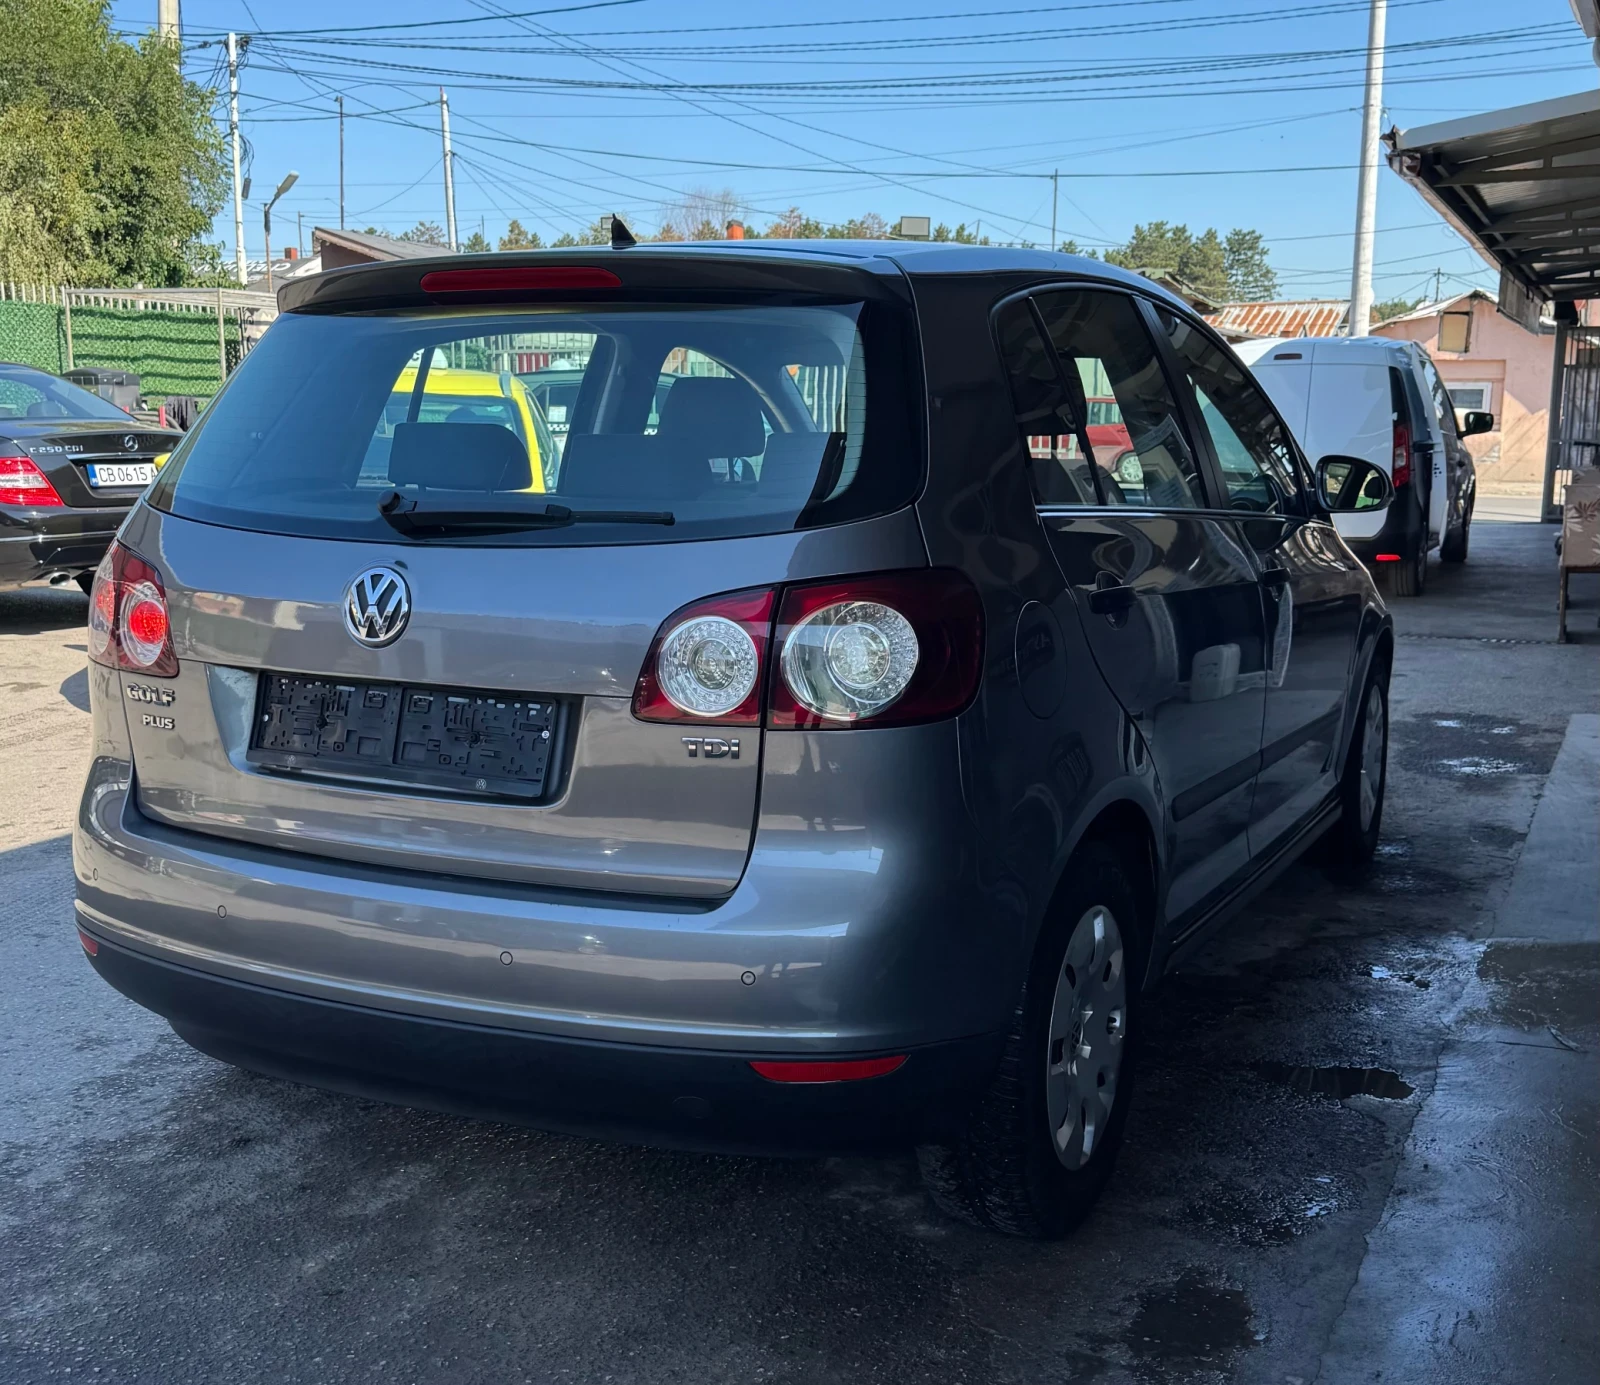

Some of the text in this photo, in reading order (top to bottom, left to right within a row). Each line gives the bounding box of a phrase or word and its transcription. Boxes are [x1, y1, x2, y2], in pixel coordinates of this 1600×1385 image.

[65, 444, 83, 452] CDI
[99, 467, 116, 482] CB
[117, 466, 147, 482] 0615
[346, 567, 410, 642] VW
[127, 682, 176, 707] GOLF
[142, 714, 175, 730] PLUS
[682, 737, 740, 760] TDI
